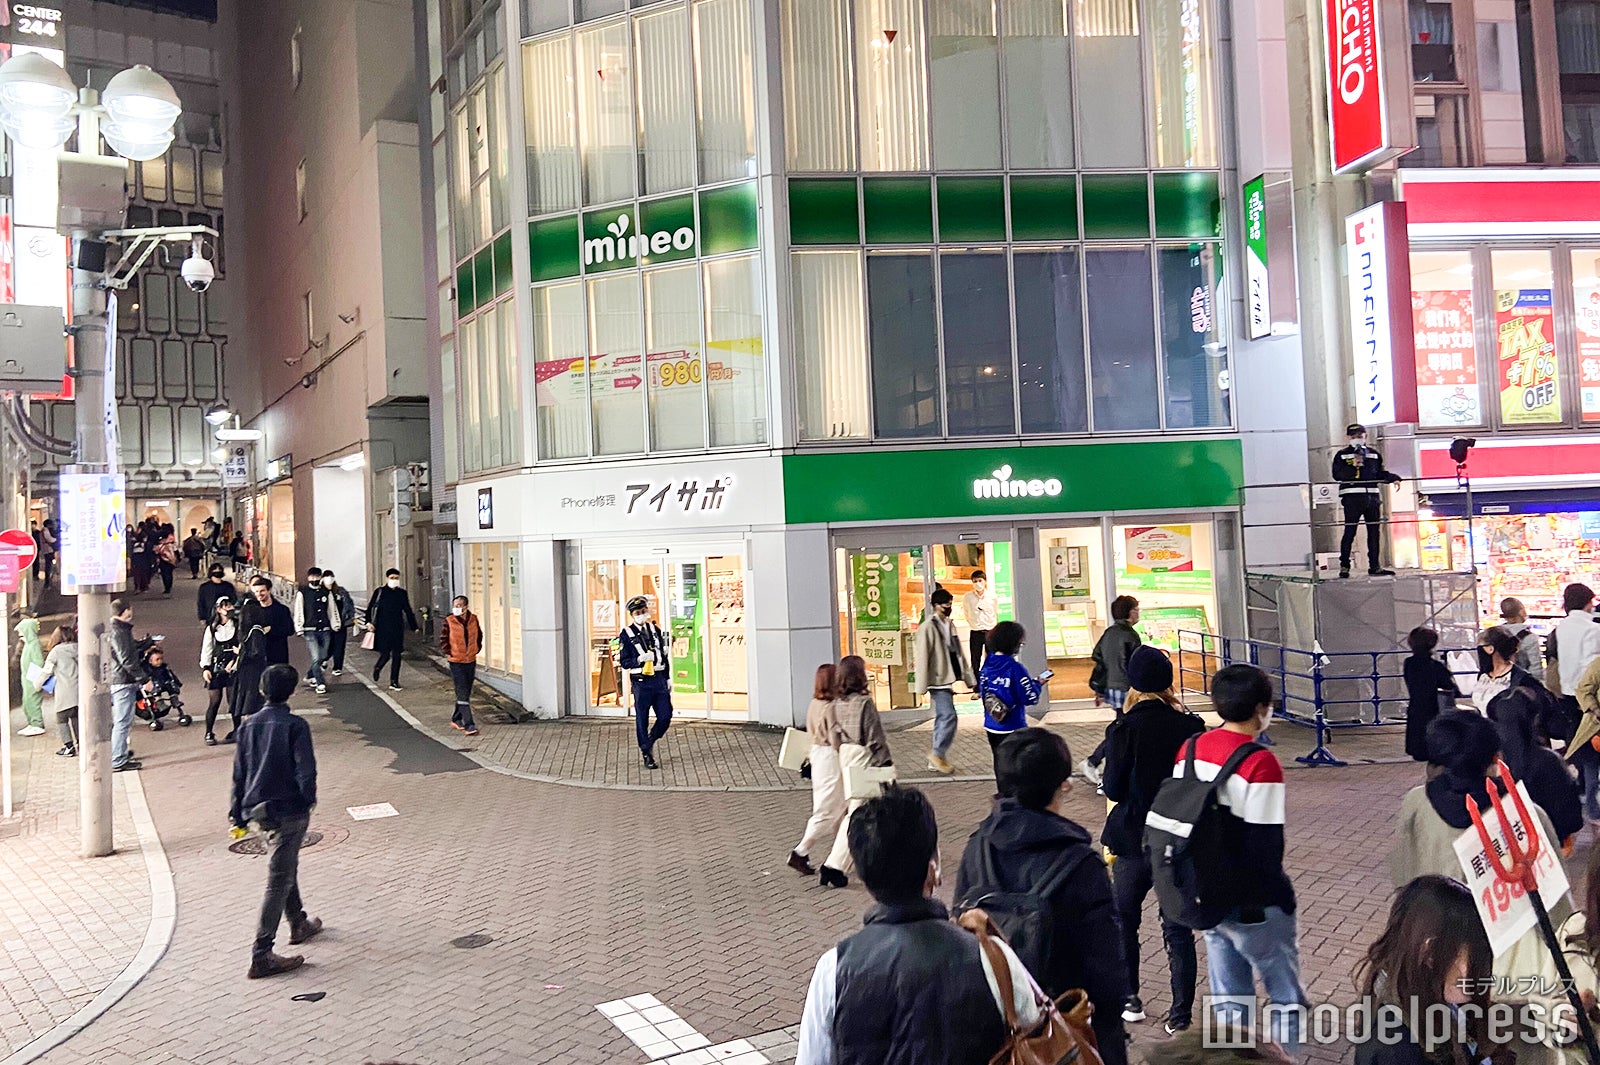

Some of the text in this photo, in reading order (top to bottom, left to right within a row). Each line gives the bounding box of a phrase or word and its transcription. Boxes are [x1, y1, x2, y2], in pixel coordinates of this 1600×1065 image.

[13, 4, 62, 21] CENTER
[18, 18, 57, 37] 244
[584, 214, 695, 266] mineo
[1361, 252, 1381, 413] ココカラファイン
[1498, 318, 1546, 360] TAX
[1524, 382, 1555, 410] OFF
[973, 464, 1063, 499] mineo
[561, 494, 616, 508] iPhone修理
[625, 476, 733, 514] アイサポ
[719, 635, 746, 646] アイサ
[861, 637, 896, 647] マイネオ
[864, 648, 894, 659] 取扱店
